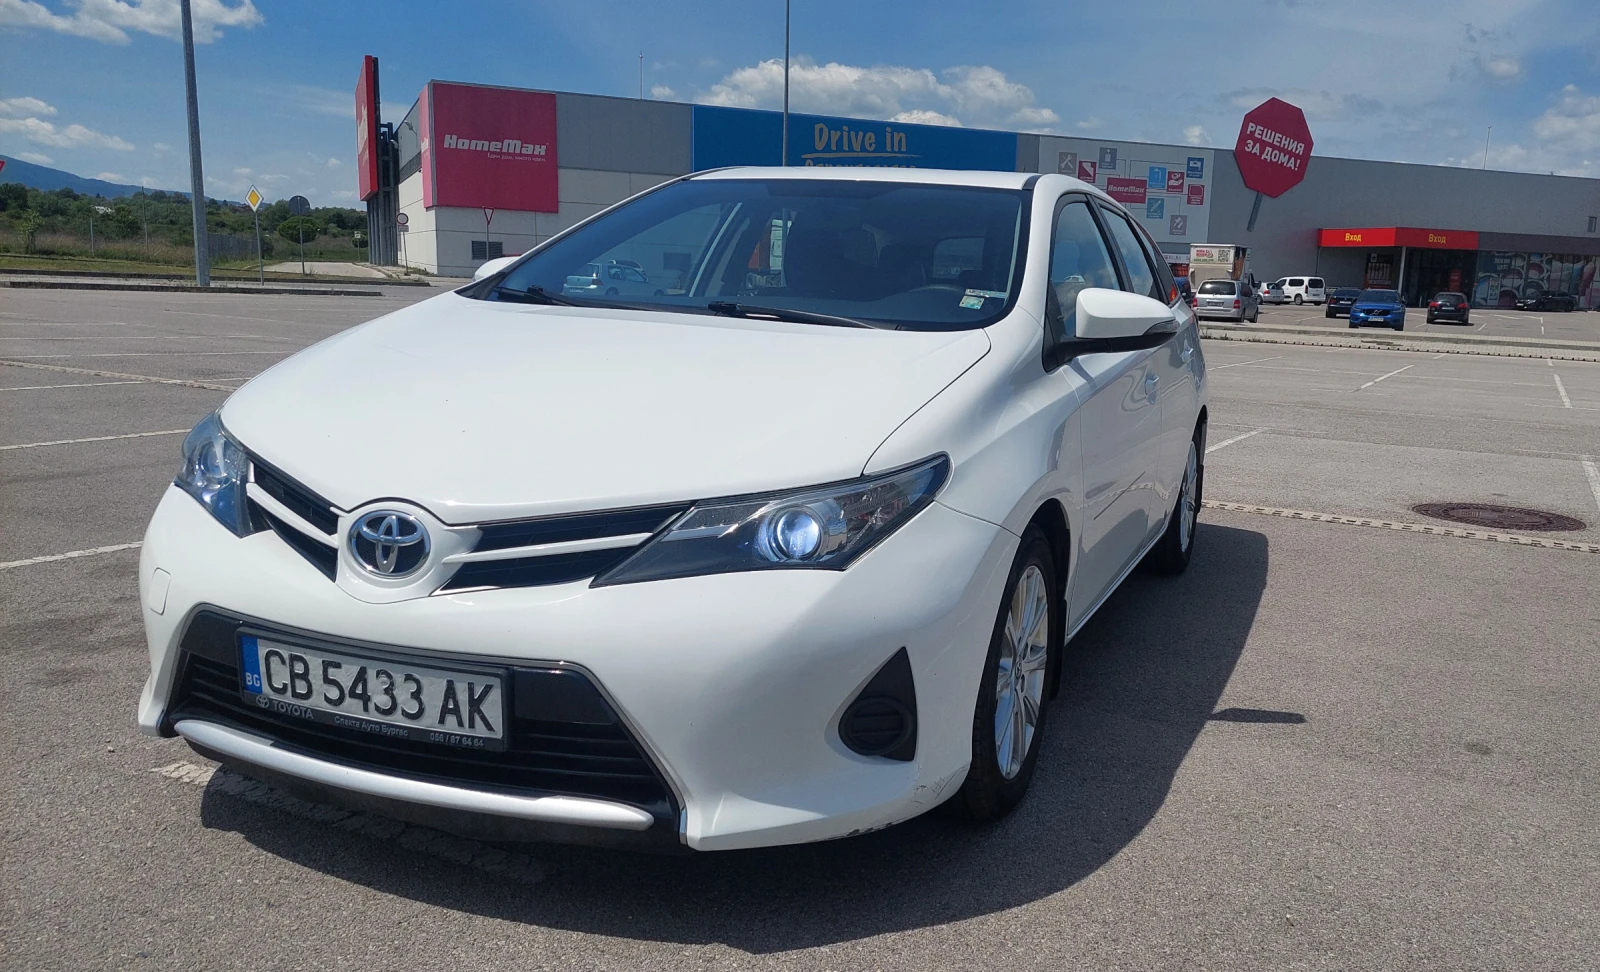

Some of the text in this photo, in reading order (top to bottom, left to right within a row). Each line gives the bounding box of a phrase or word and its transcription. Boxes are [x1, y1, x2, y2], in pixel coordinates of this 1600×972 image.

[443, 134, 547, 155] HomeMax
[814, 122, 907, 152] Drive in
[1246, 122, 1305, 156] РЕШЕНИЯ
[1244, 139, 1301, 171] ЗА ДОМА!
[1345, 232, 1362, 243] Вход
[1428, 233, 1447, 245] Вход
[245, 671, 261, 687] BG
[264, 648, 496, 732] CB 5433 AK
[272, 700, 315, 720] TOYOTA
[361, 722, 380, 732] Ауто
[381, 724, 409, 737] Бургас
